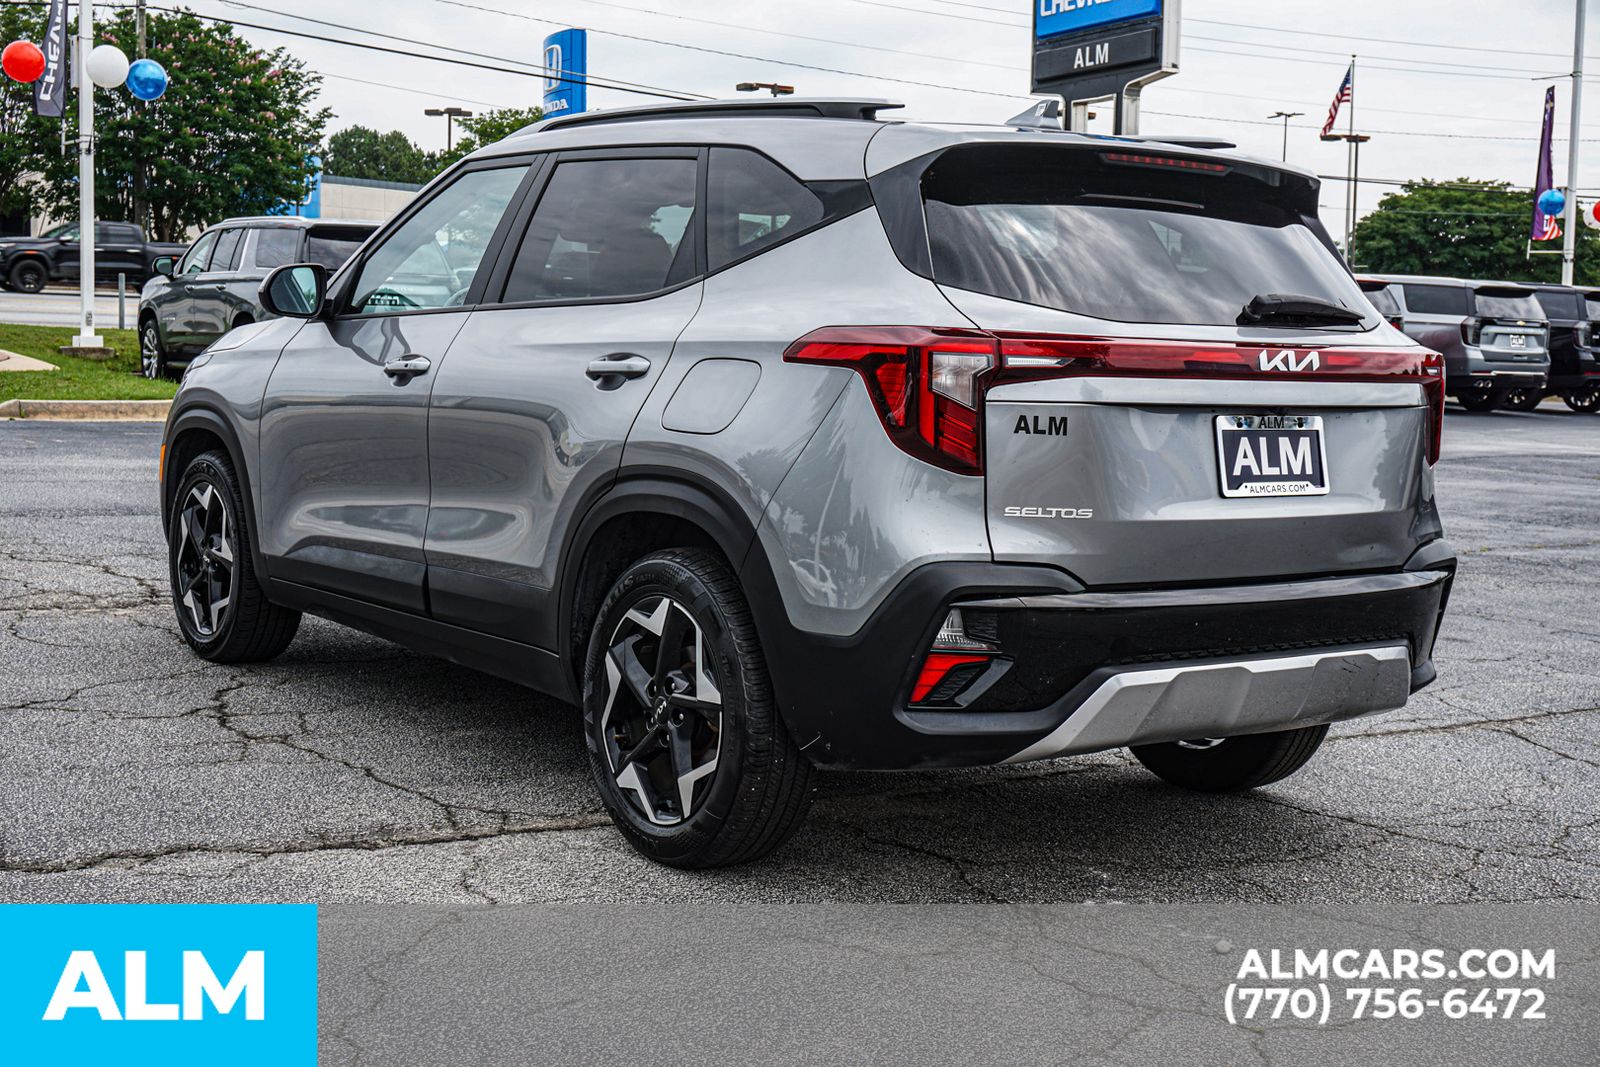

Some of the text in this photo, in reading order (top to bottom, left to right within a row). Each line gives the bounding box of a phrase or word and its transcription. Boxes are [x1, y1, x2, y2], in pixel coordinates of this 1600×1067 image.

[1073, 43, 1109, 69] ALM
[1259, 349, 1320, 372] KIA
[1013, 415, 1068, 436] ALM
[1258, 416, 1285, 429] ALM
[1232, 437, 1313, 476] ALM
[1249, 484, 1306, 494] ALMCARS.COM
[1003, 506, 1093, 519] SELTOS
